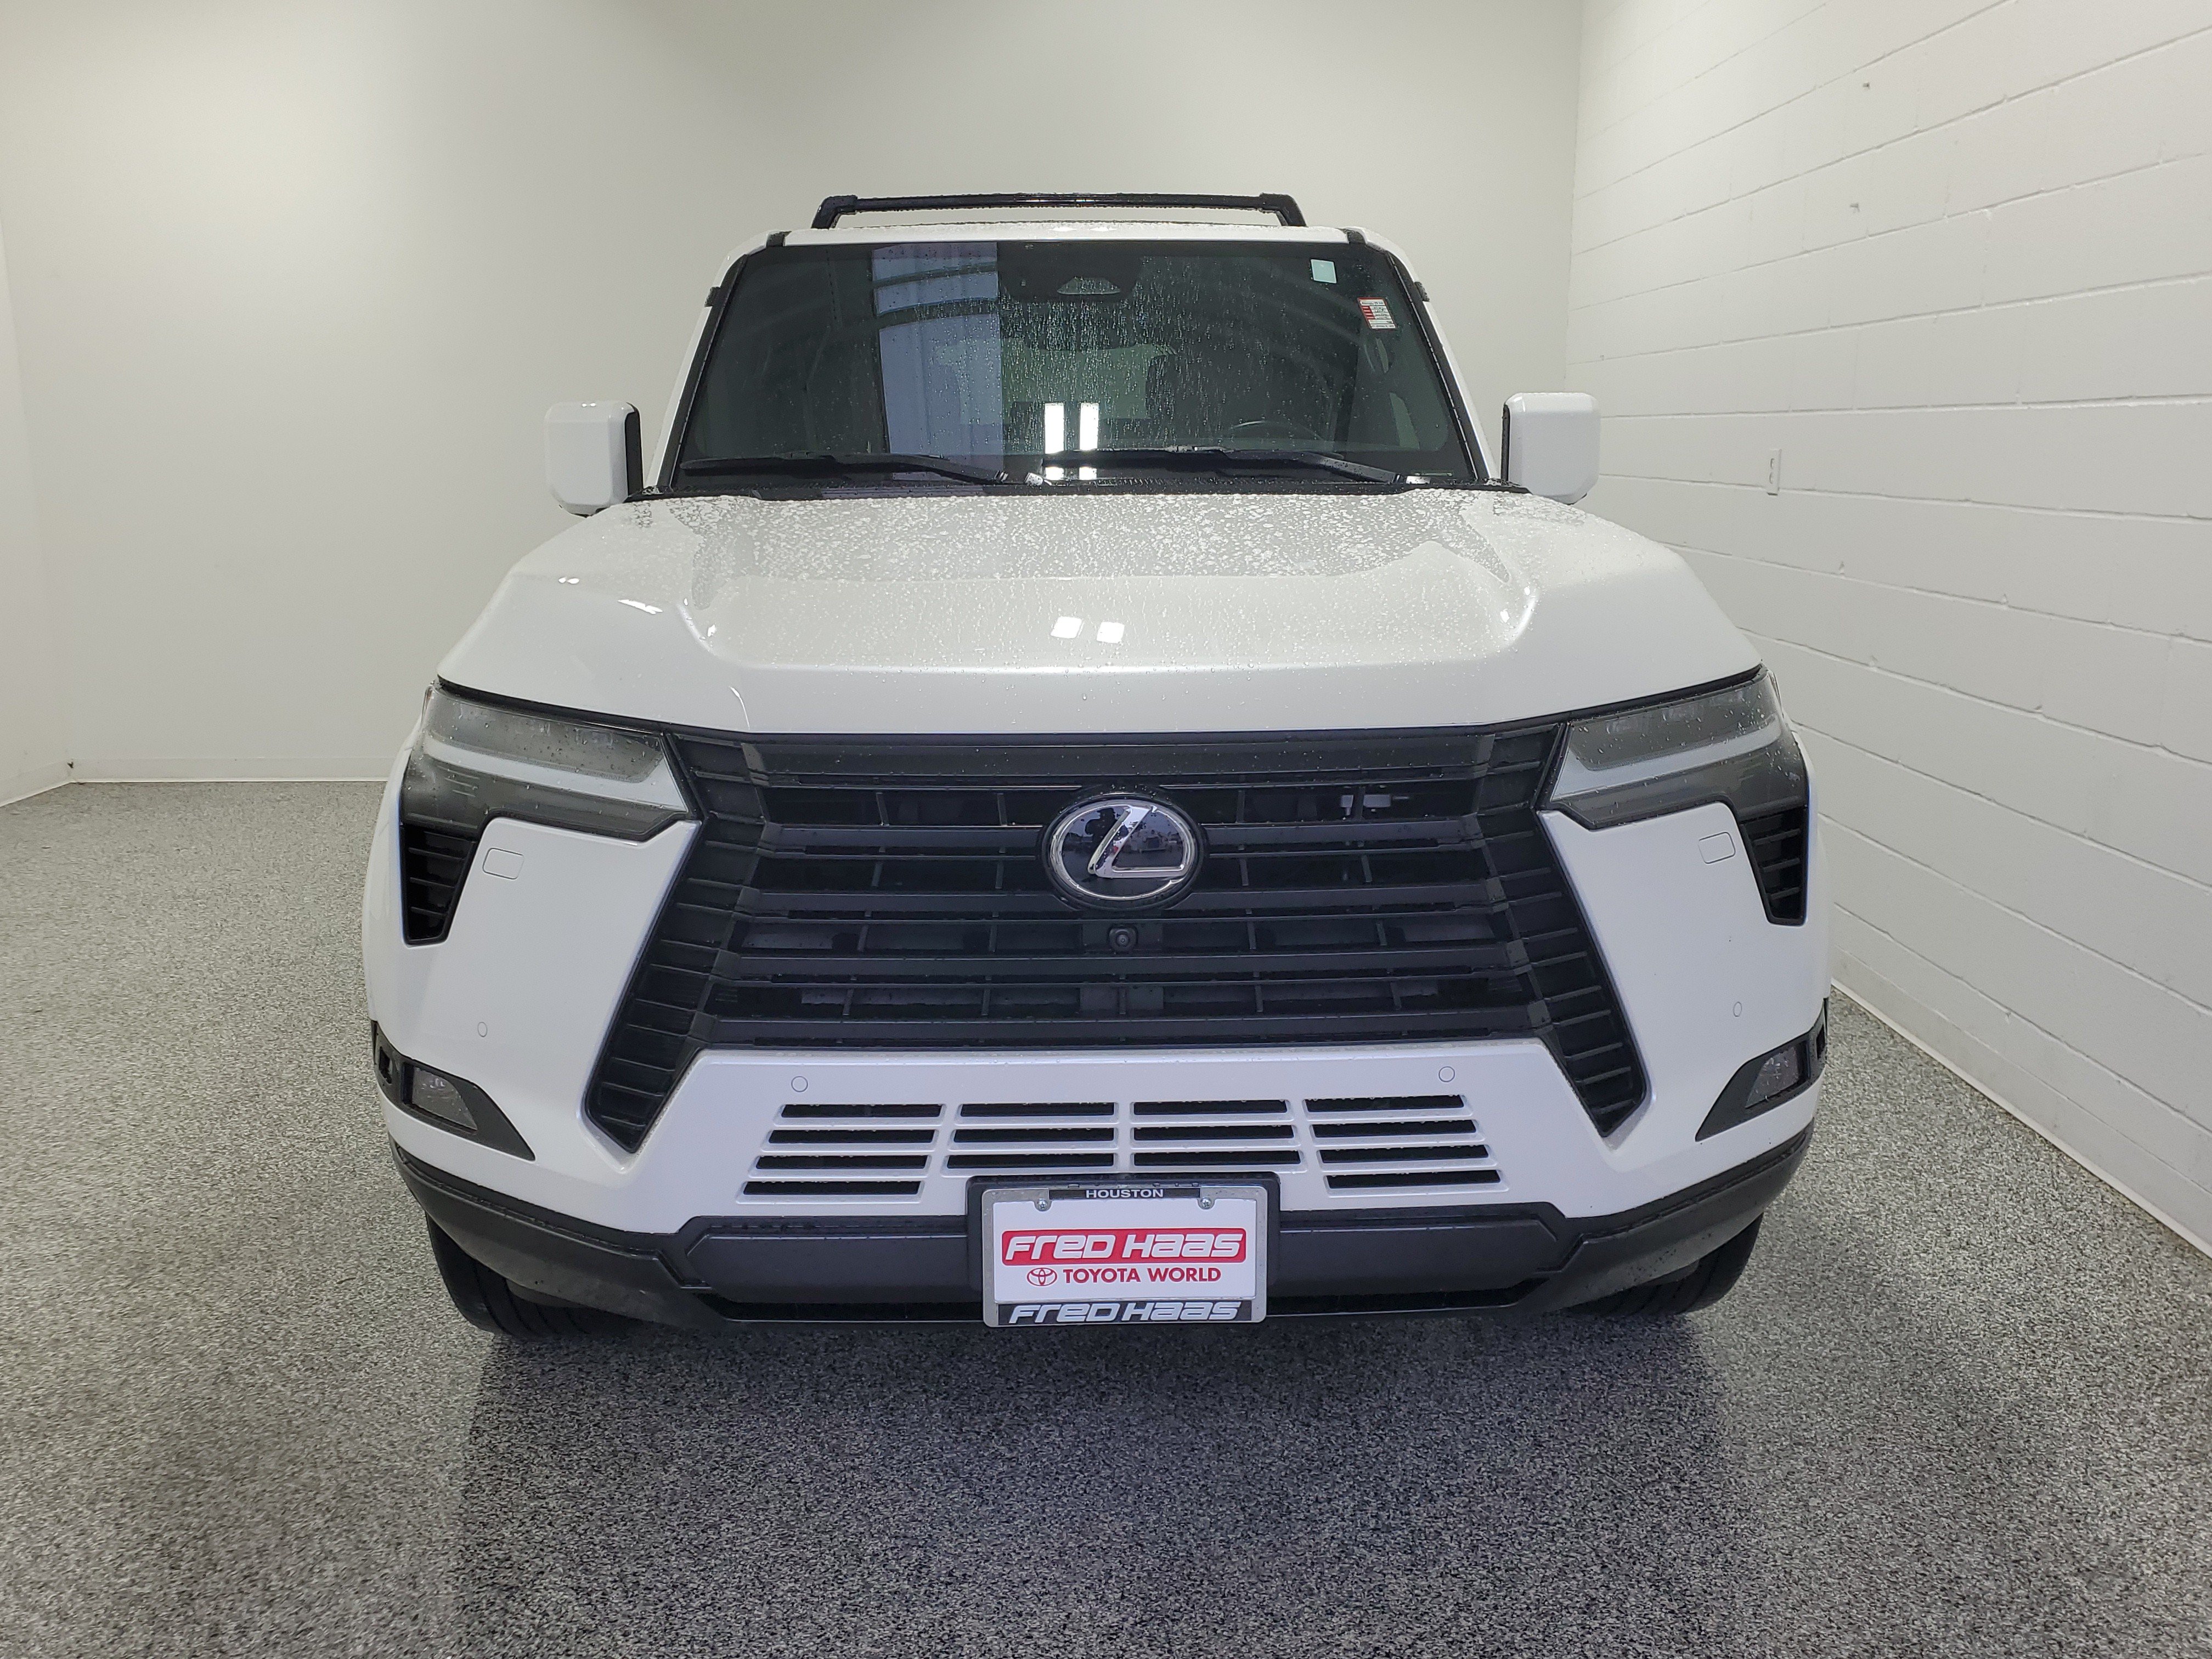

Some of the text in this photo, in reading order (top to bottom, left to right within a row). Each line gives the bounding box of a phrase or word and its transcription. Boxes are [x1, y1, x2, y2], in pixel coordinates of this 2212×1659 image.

[1086, 1189, 1164, 1199] HOUSTON
[1063, 1267, 1221, 1283] TOYOTA WORLD
